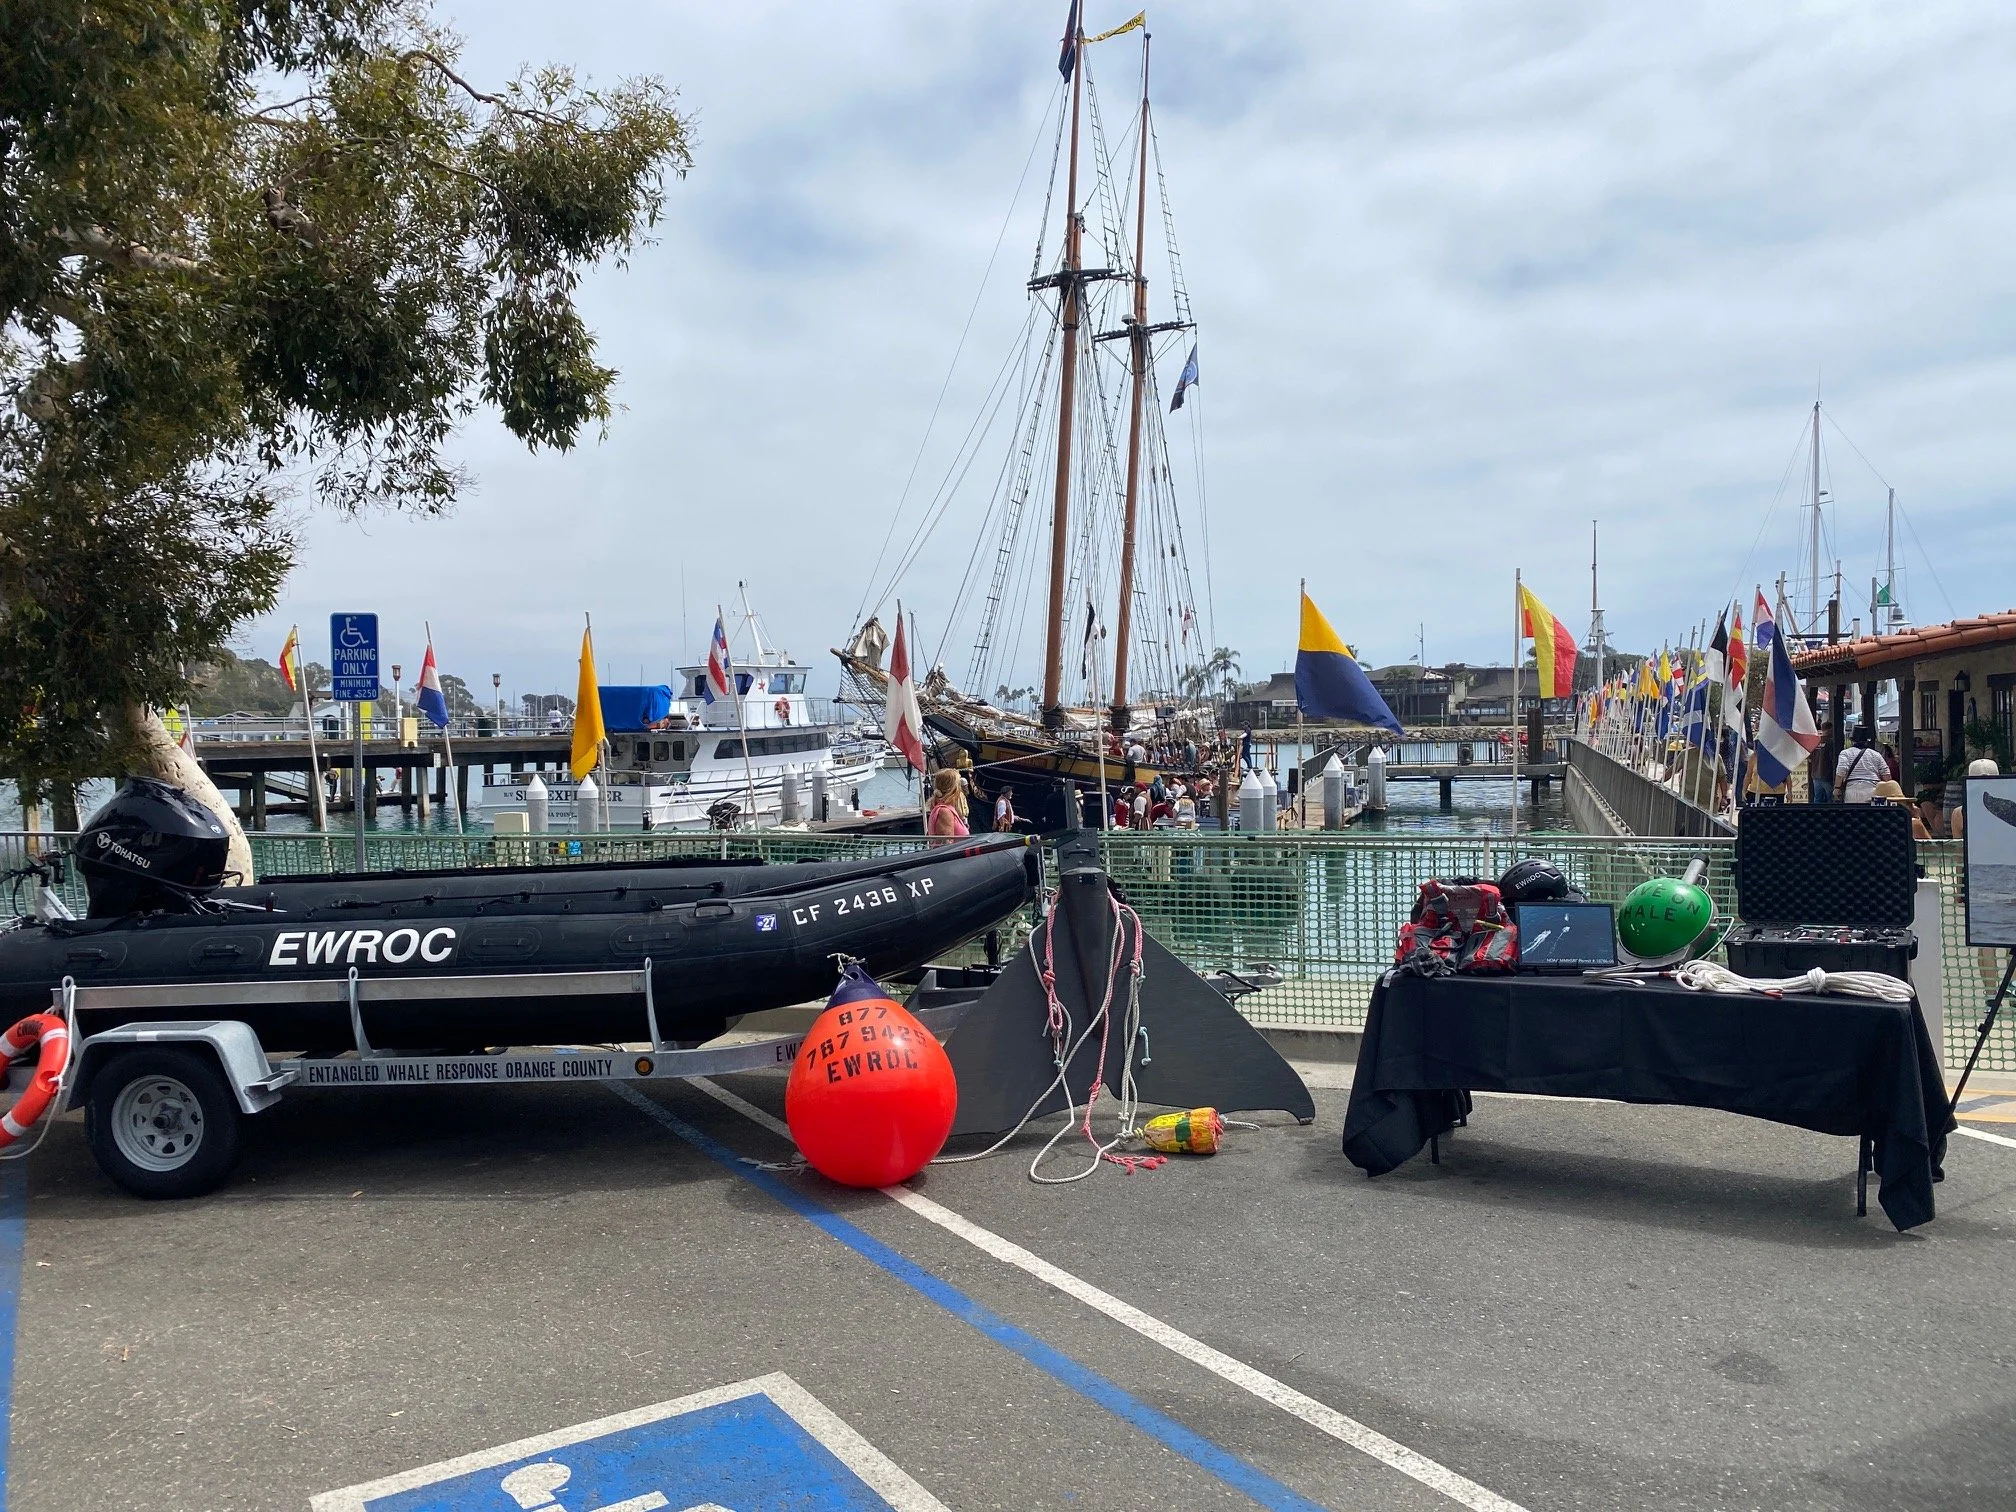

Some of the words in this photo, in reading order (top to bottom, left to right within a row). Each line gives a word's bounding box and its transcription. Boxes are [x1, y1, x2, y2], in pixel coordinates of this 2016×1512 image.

[334, 648, 376, 661] PARKING
[342, 662, 368, 675] ONLY
[340, 679, 372, 688] MINIMUM
[335, 690, 351, 698] FINE
[110, 841, 151, 869] TOHATSU
[1515, 872, 1540, 890] EWROC
[792, 904, 821, 926] CF
[834, 886, 898, 916] 2436
[905, 877, 934, 898] XP
[1671, 893, 1701, 915] ON
[762, 917, 775, 929] 27
[269, 927, 456, 966] EWROC
[838, 1007, 888, 1026] 877
[309, 1065, 379, 1083] ENTANGLED
[386, 1063, 429, 1081] WHALE
[436, 1062, 498, 1080] RESPONSE
[505, 1061, 556, 1078] ORANGE
[562, 1059, 612, 1077] COUNTY
[826, 1049, 918, 1084] EWROC
